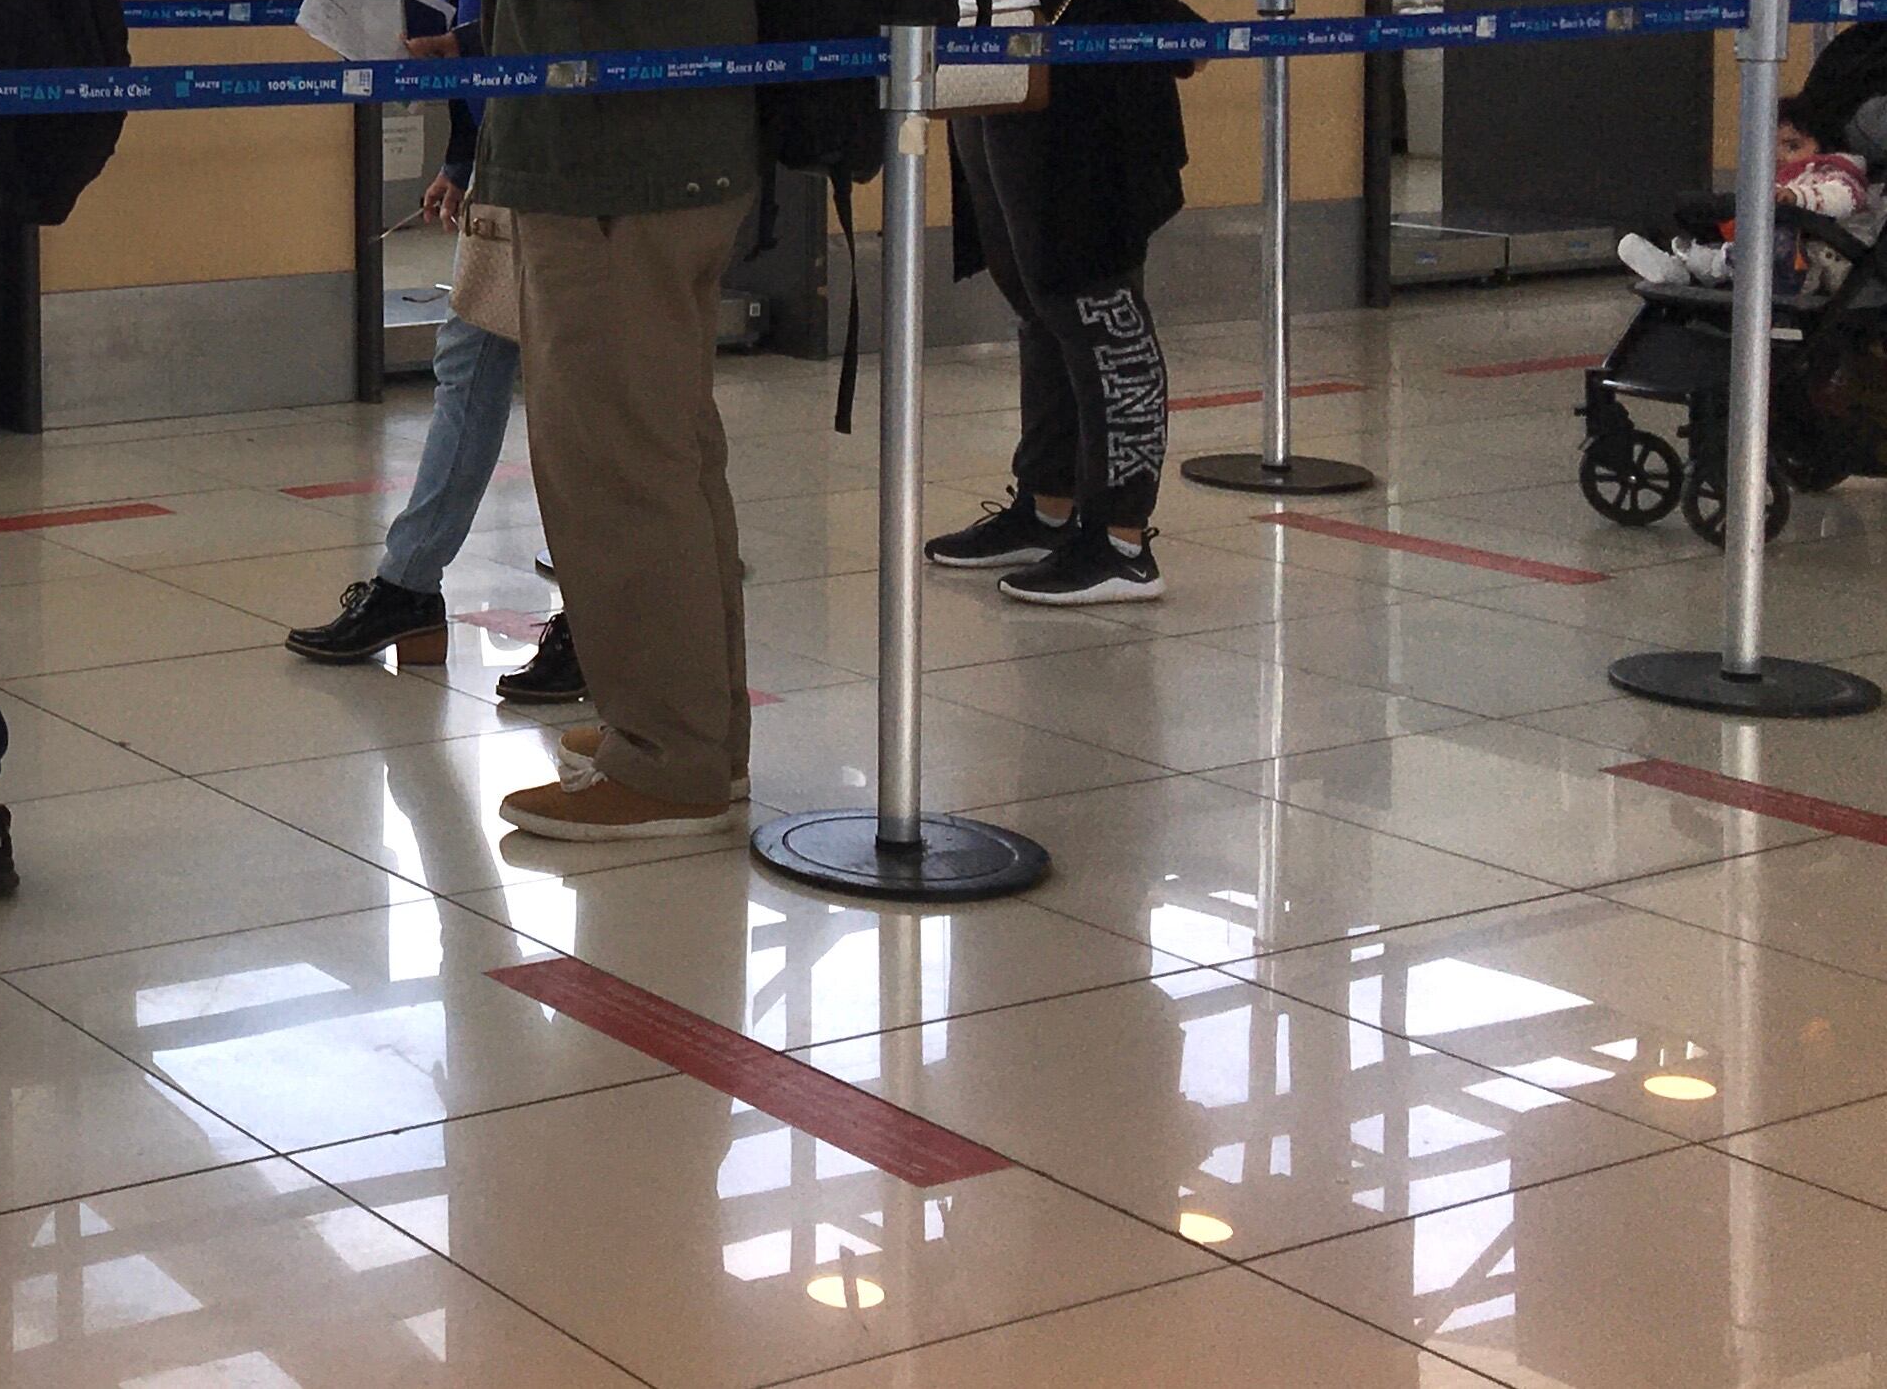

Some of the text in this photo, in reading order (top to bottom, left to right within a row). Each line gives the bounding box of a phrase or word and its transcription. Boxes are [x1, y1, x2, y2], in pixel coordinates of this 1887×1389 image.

[840, 52, 873, 66] FAN
[628, 65, 663, 80] FAN
[194, 79, 337, 95] HAZTE FAN 100% ONLINE
[395, 77, 418, 85] HAZTE
[419, 75, 458, 90] FAN
[472, 73, 501, 87] Banco
[502, 73, 512, 86] de
[515, 72, 538, 85] Chile
[20, 85, 62, 100] FAN
[79, 83, 111, 98] Banco
[113, 85, 124, 98] de
[127, 83, 153, 97] Chile
[1076, 288, 1167, 487] PINK
